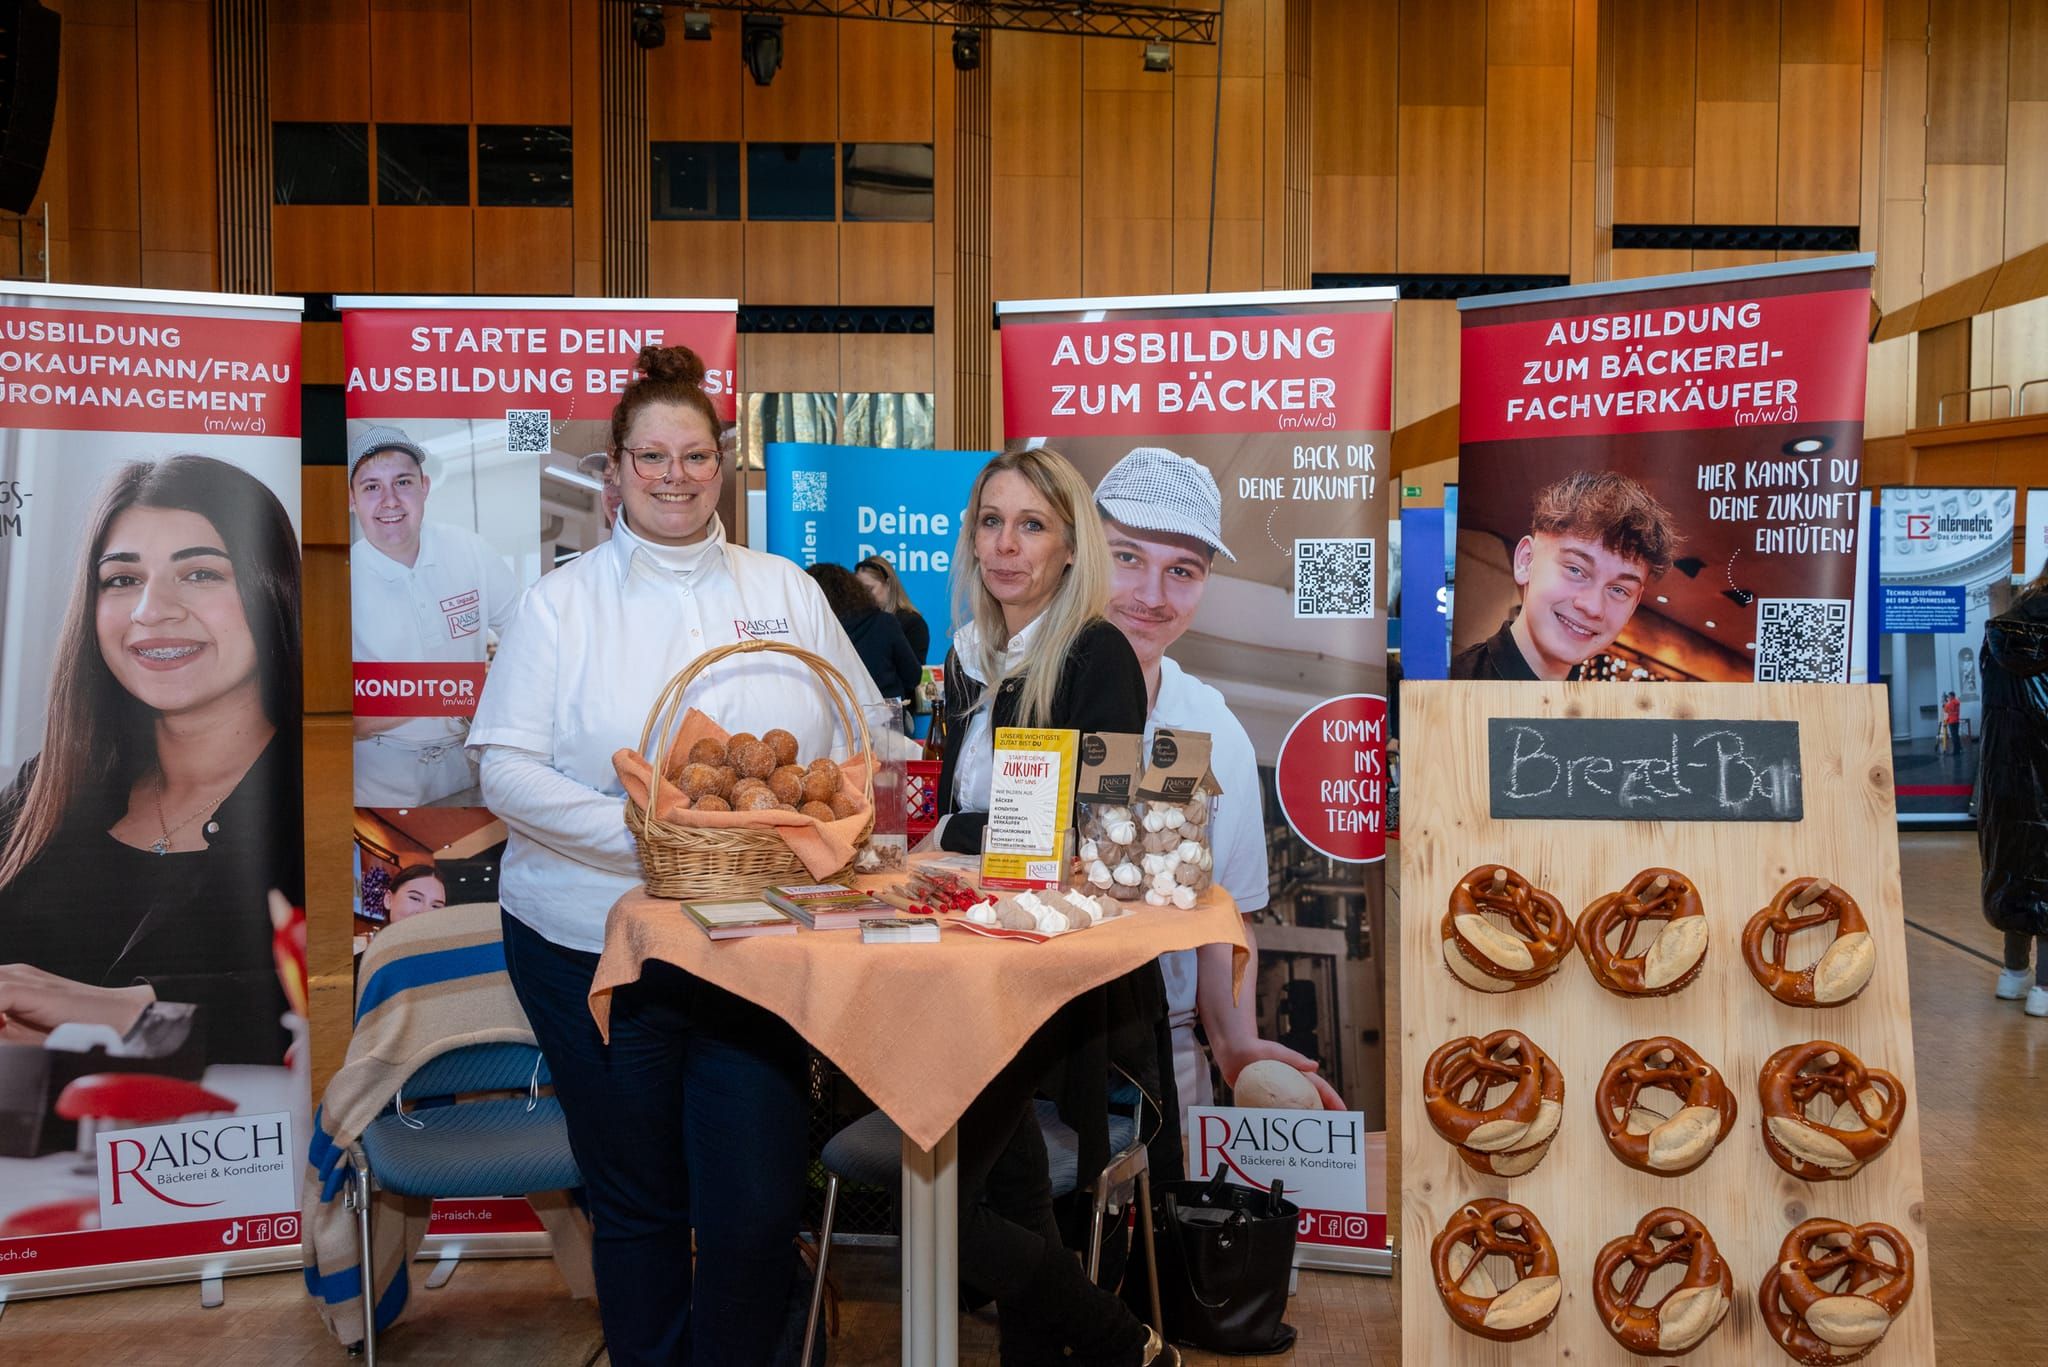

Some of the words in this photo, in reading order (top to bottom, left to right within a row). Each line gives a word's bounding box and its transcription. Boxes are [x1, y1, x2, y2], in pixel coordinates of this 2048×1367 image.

[1545, 302, 1761, 346] AUSBILDUNG
[411, 327, 547, 354] STARTE
[559, 328, 665, 354] DEINE
[1051, 327, 1336, 366] AUSBILDUNG
[1522, 356, 1589, 385] ZUM
[1601, 341, 1784, 379] BÄCKEREI-
[346, 367, 574, 394] AUSBILDUNG
[1051, 383, 1141, 416] ZUM
[1158, 371, 1337, 413] BÄCKER
[1506, 379, 1799, 422] FACHVERKÄUFER
[204, 416, 266, 434] (m/w/d)
[1278, 413, 1337, 430] (m/w/d)
[1735, 406, 1799, 427] (m/w/d)
[1293, 445, 1339, 470] BACK
[1347, 443, 1375, 470] DIR
[1239, 477, 1285, 500] DEINE
[1292, 474, 1375, 500] ZUKUNFT!
[1698, 464, 1737, 492] HIER
[1745, 459, 1820, 489] KANNST
[1830, 457, 1859, 487] DU
[858, 505, 950, 535] Deine
[1709, 495, 1759, 521] DEINE
[1766, 492, 1857, 521] ZUKUNFT
[1937, 513, 1993, 532] intermetric
[1755, 523, 1854, 555] EINTÜTEN!
[734, 618, 788, 640] RAISCH
[355, 679, 475, 698] KONDITOR
[442, 697, 476, 707] (m/w/d)
[1003, 761, 1051, 779] ZUKUNFT
[1354, 749, 1381, 775] INS
[1320, 779, 1380, 806] RAISCH
[1325, 808, 1380, 833] TEAM!
[108, 1121, 285, 1207] RAISCH
[1198, 1115, 1357, 1193] RAISCH
[1240, 1155, 1285, 1167] Bäckerei
[1288, 1156, 1297, 1167] &
[1300, 1157, 1357, 1170] Konditorei
[157, 1168, 208, 1185] Bäckerei
[210, 1167, 221, 1179] &
[223, 1160, 285, 1178] Konditorei
[431, 1209, 493, 1221] ei-raisch.de
